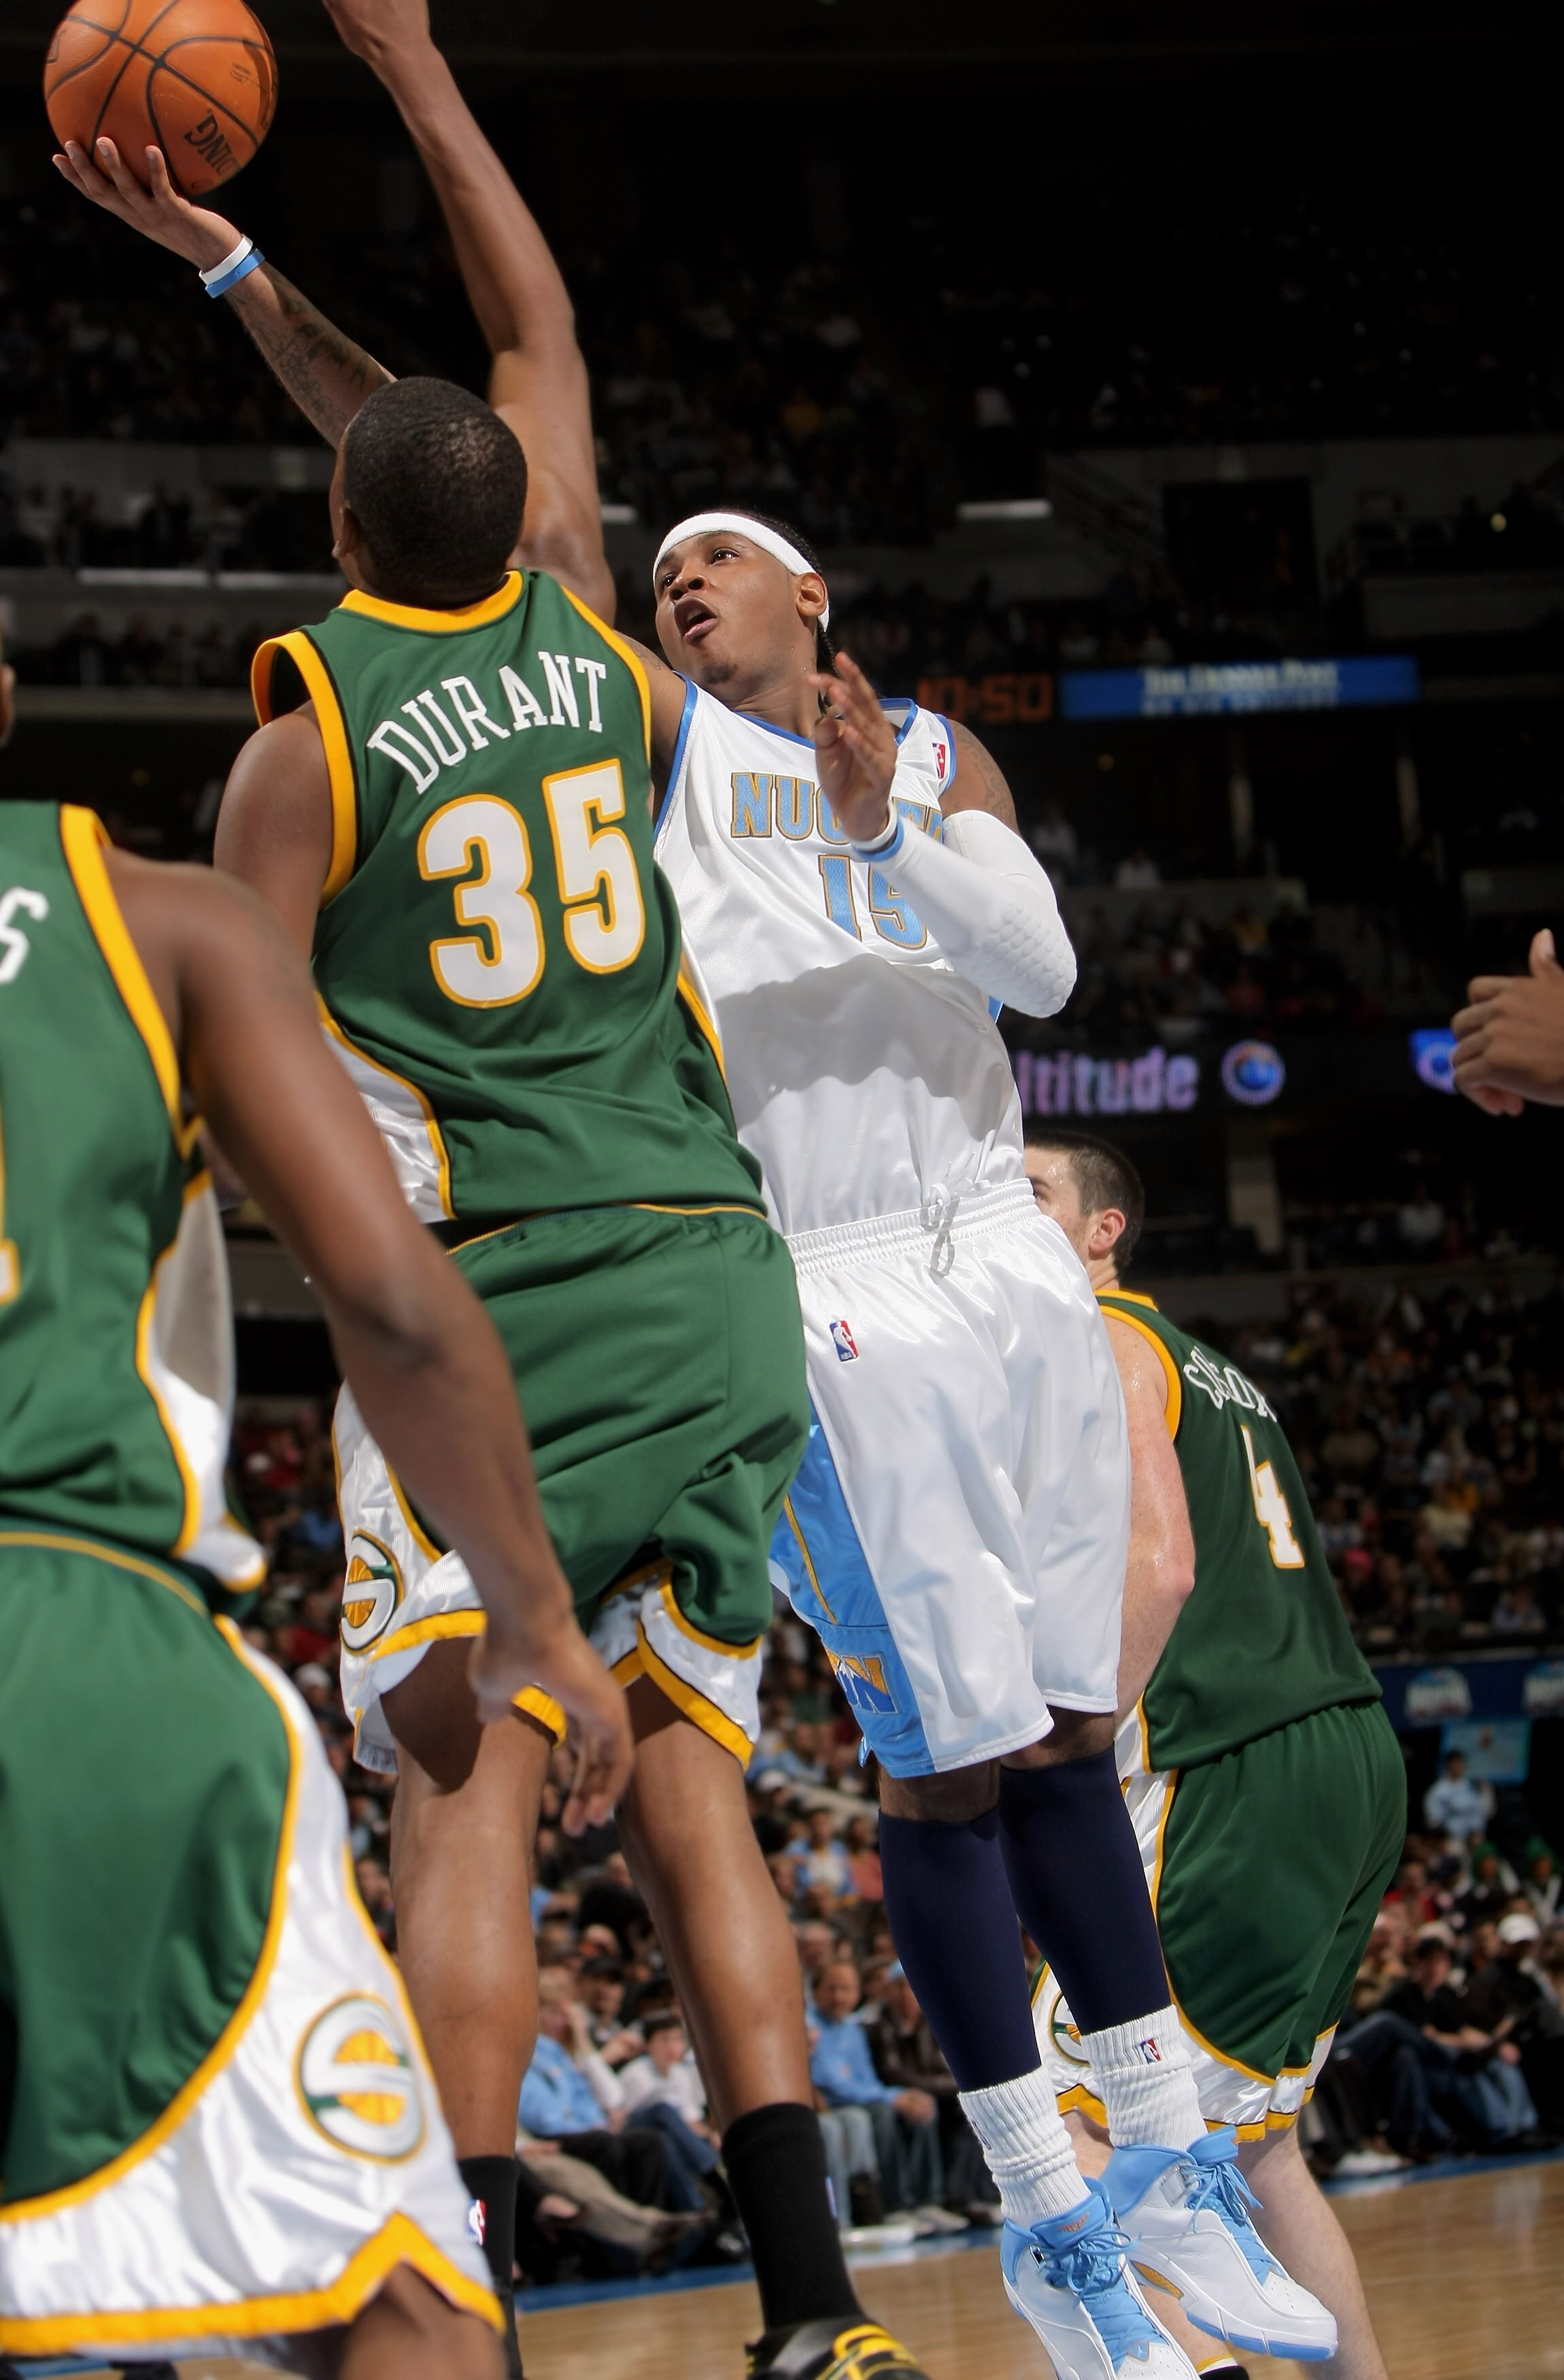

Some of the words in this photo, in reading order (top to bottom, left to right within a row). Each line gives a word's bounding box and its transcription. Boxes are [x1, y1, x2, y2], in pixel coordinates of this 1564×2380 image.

[367, 651, 607, 794] DURANT
[417, 758, 646, 1009] 35
[818, 854, 928, 950] 15
[1240, 1423, 1306, 1569] 4
